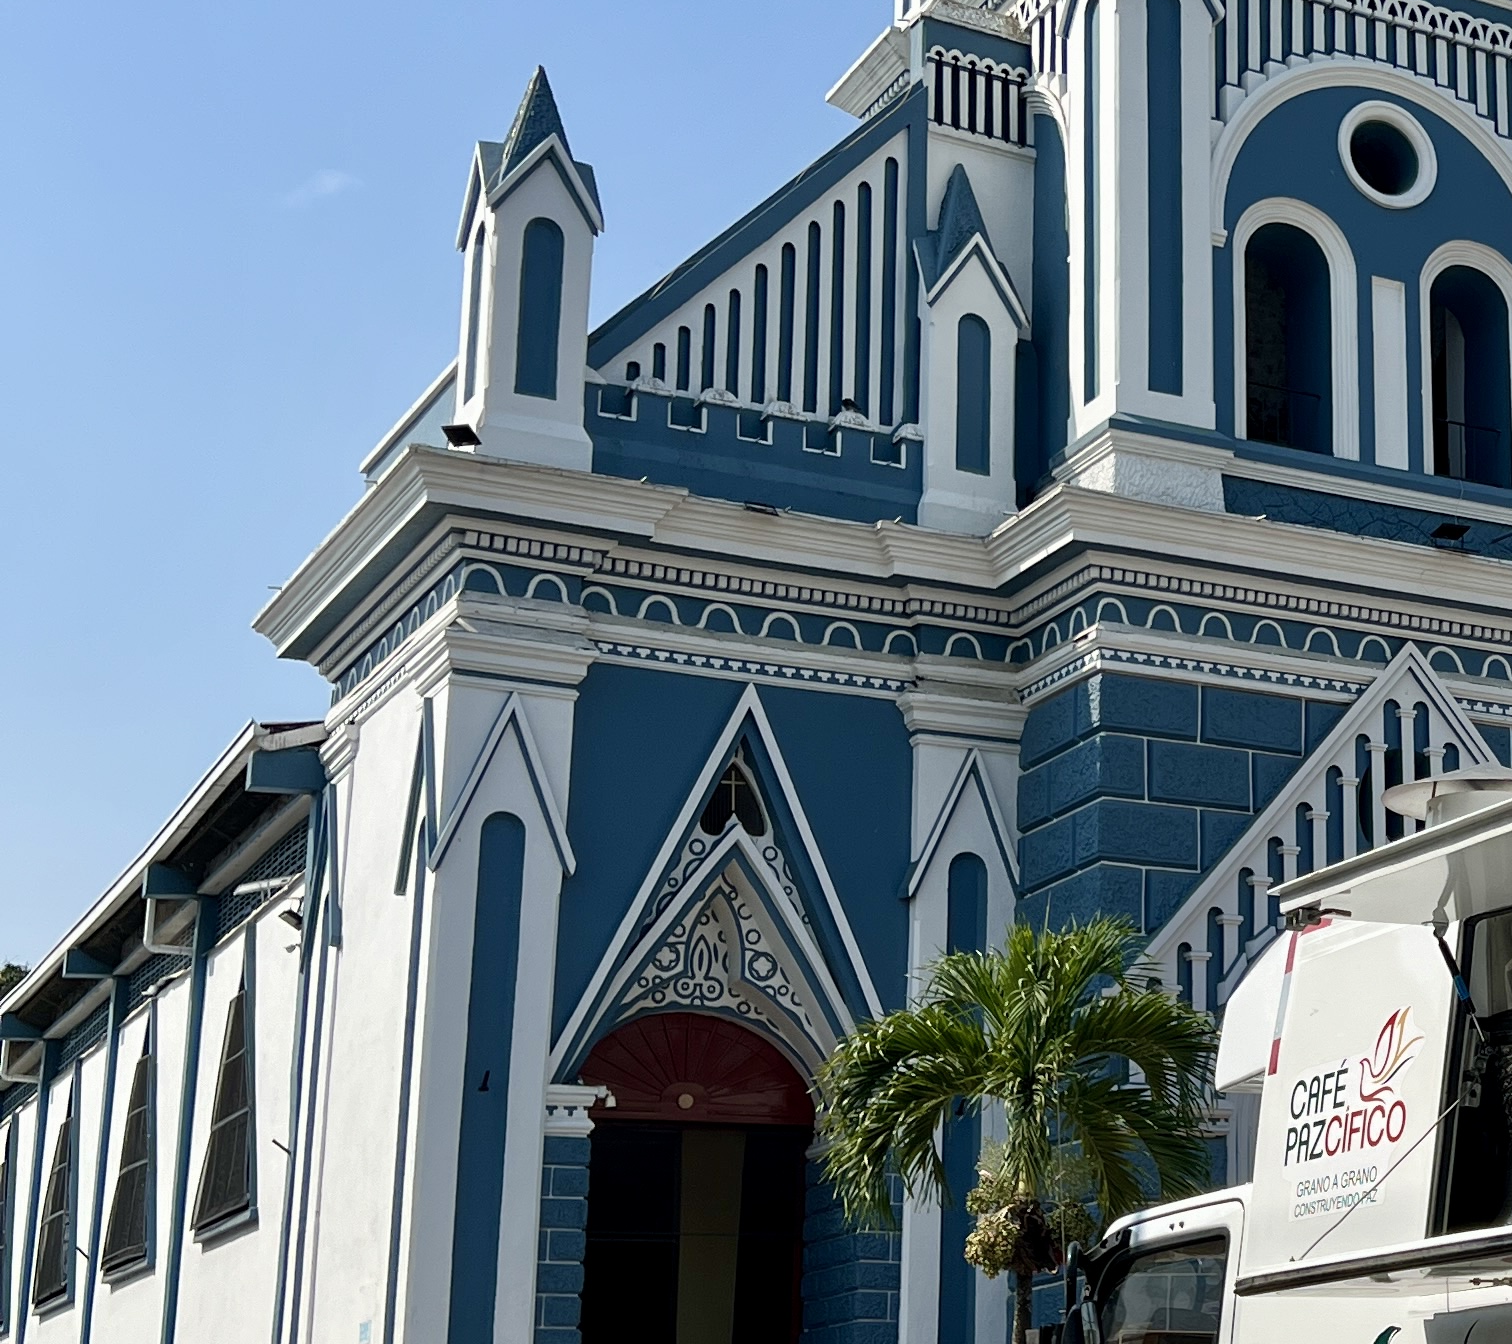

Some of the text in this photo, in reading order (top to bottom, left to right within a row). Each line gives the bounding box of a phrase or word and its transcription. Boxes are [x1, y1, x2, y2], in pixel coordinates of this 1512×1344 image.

[1290, 1059, 1349, 1120] CAFÉ
[1284, 1100, 1407, 1167] PAZCÍFICO
[1294, 1188, 1378, 1218] CONSTRUYENDO PAZ
[1296, 1165, 1378, 1198] GRANO A GRANO
